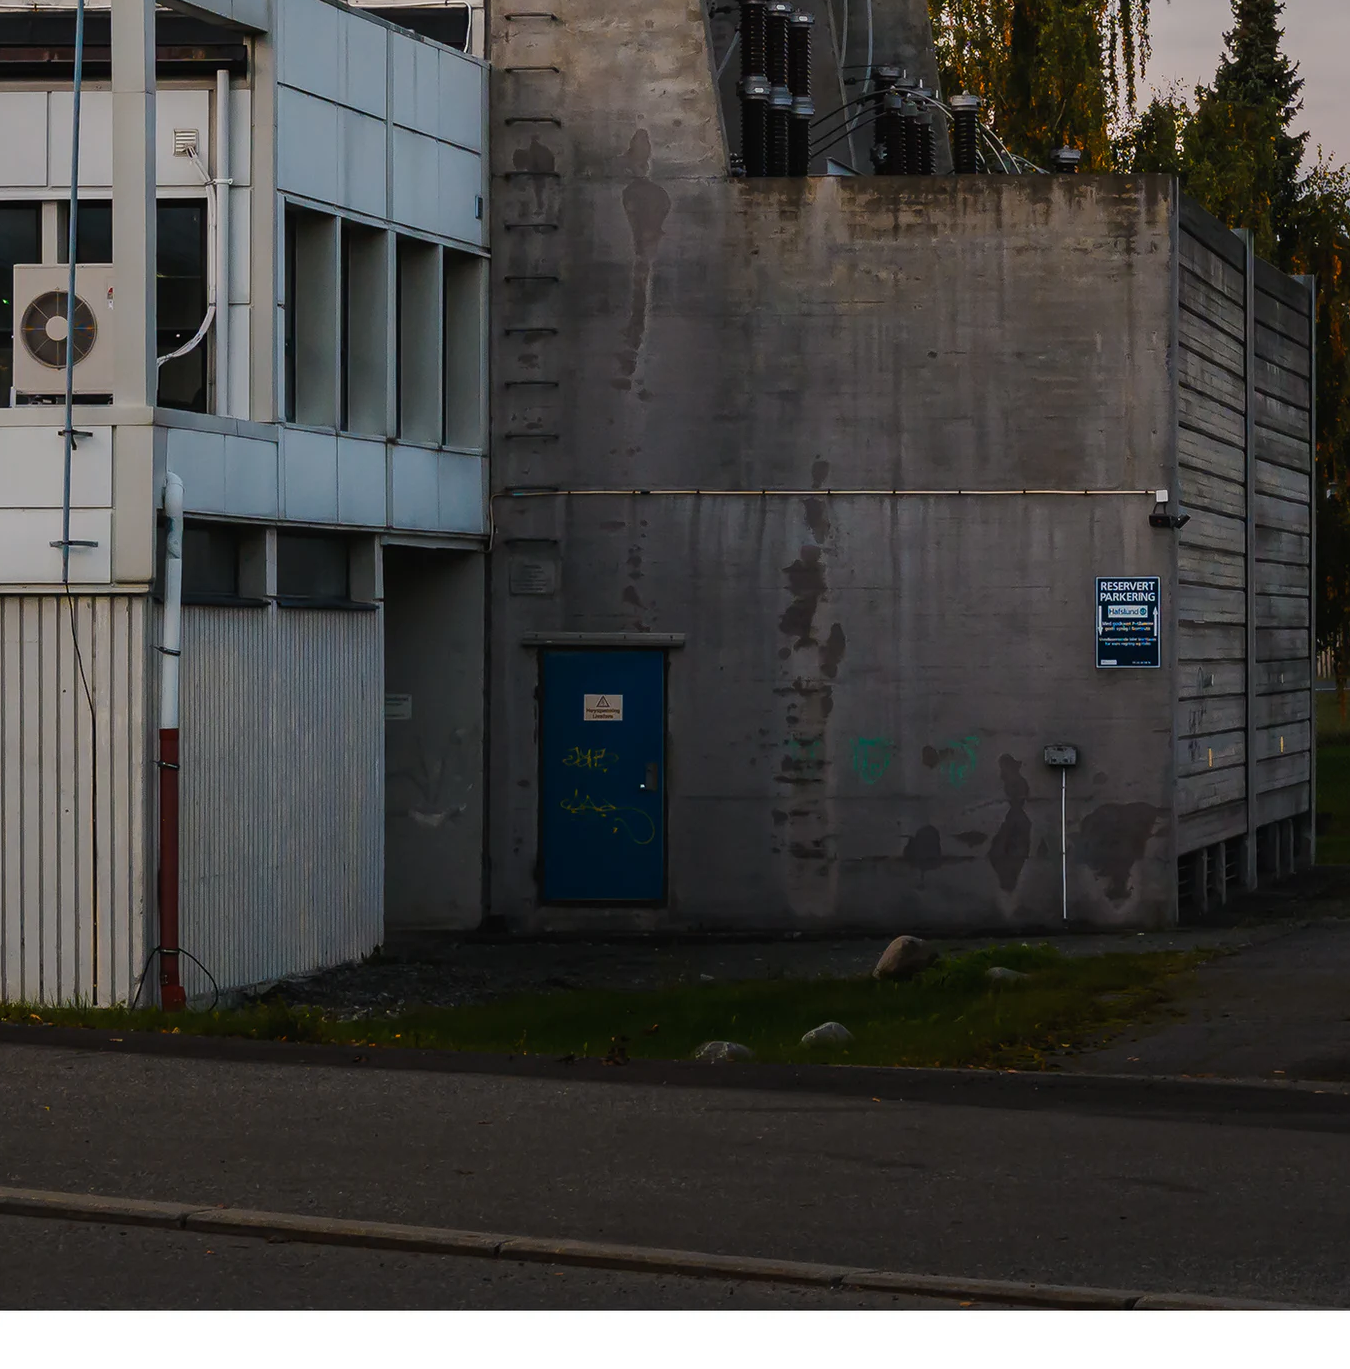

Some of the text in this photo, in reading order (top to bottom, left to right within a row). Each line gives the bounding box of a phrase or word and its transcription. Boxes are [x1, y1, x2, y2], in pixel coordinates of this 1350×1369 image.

[1100, 581, 1156, 591] RESERVERT
[1100, 592, 1156, 602] PARKERING
[1108, 607, 1139, 616] Hafslund
